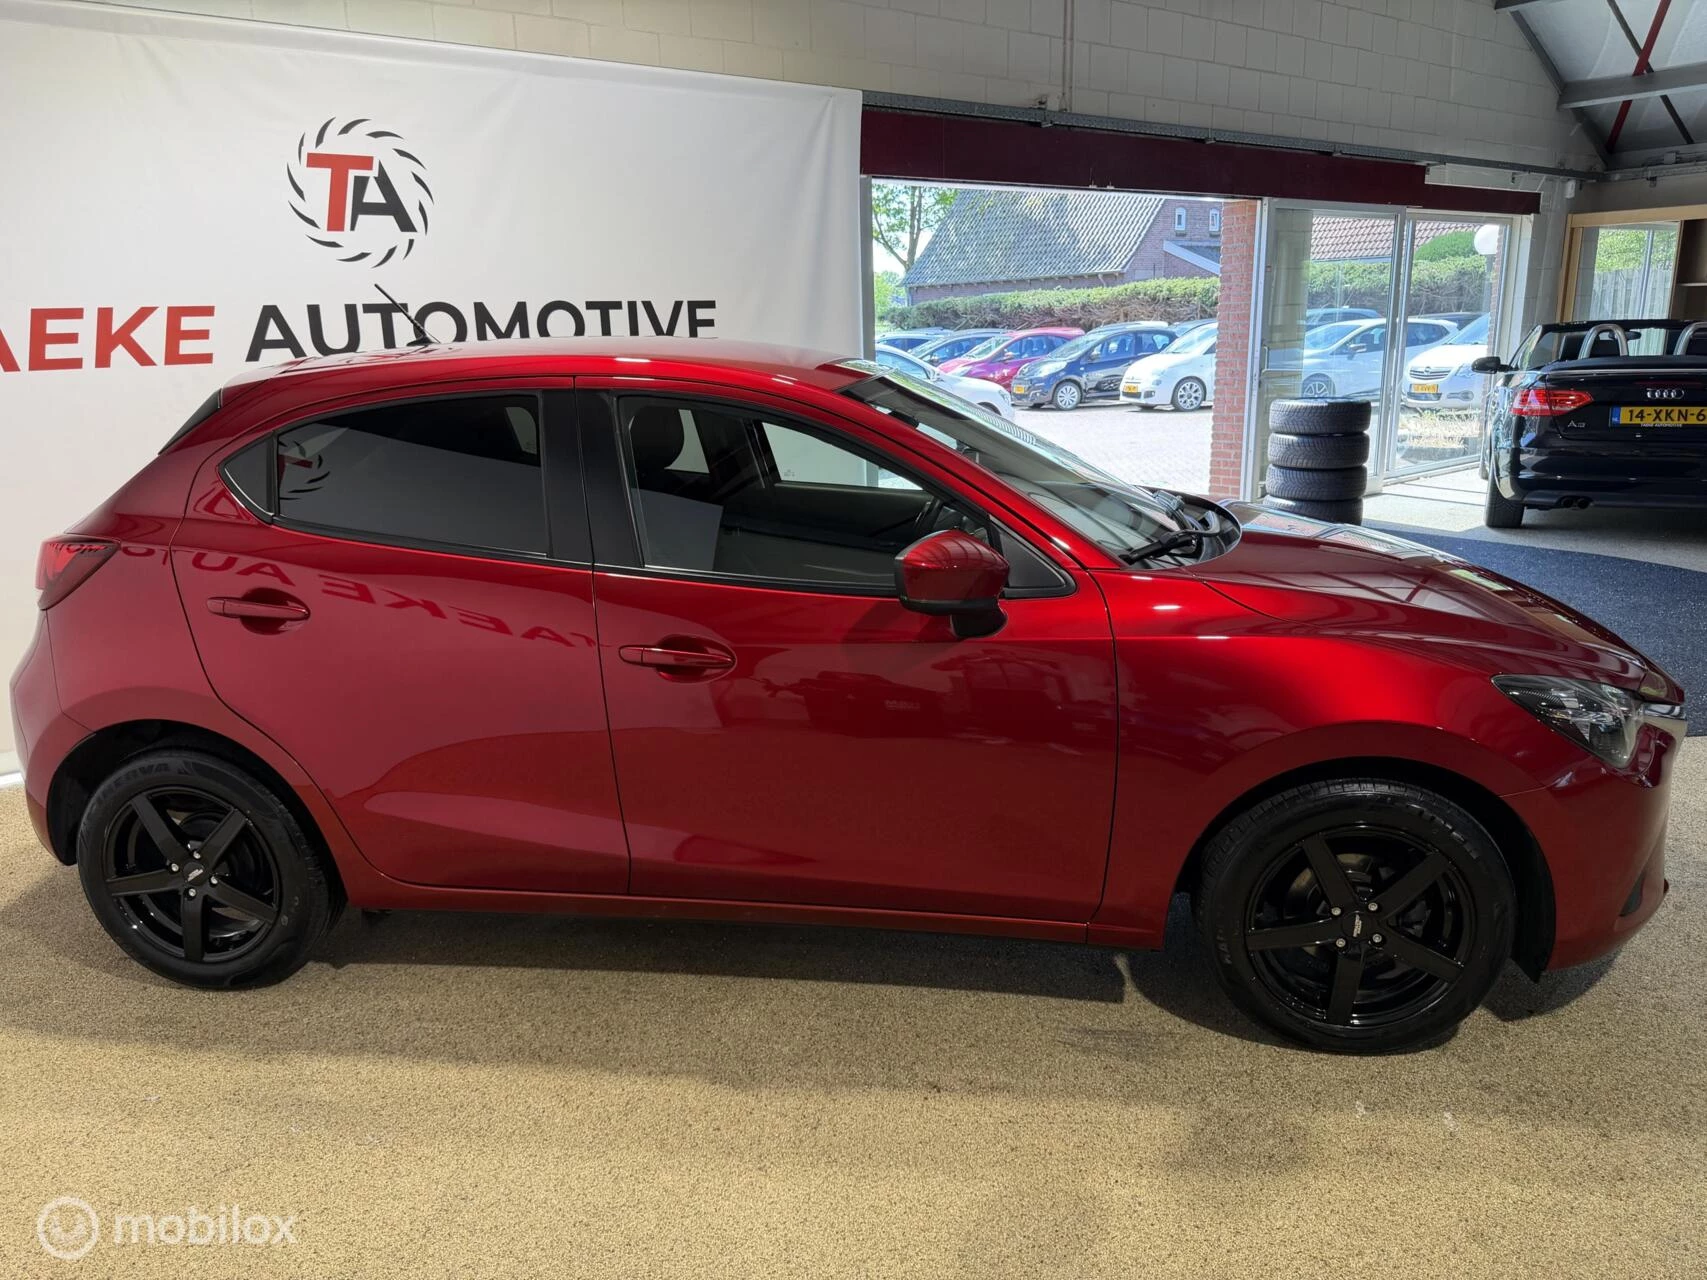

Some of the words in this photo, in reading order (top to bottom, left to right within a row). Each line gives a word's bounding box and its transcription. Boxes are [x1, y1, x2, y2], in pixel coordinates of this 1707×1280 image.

[306, 152, 417, 233] TA
[245, 299, 717, 362] AUTOMOTIVE
[1628, 408, 1706, 422] 14-XKN-6
